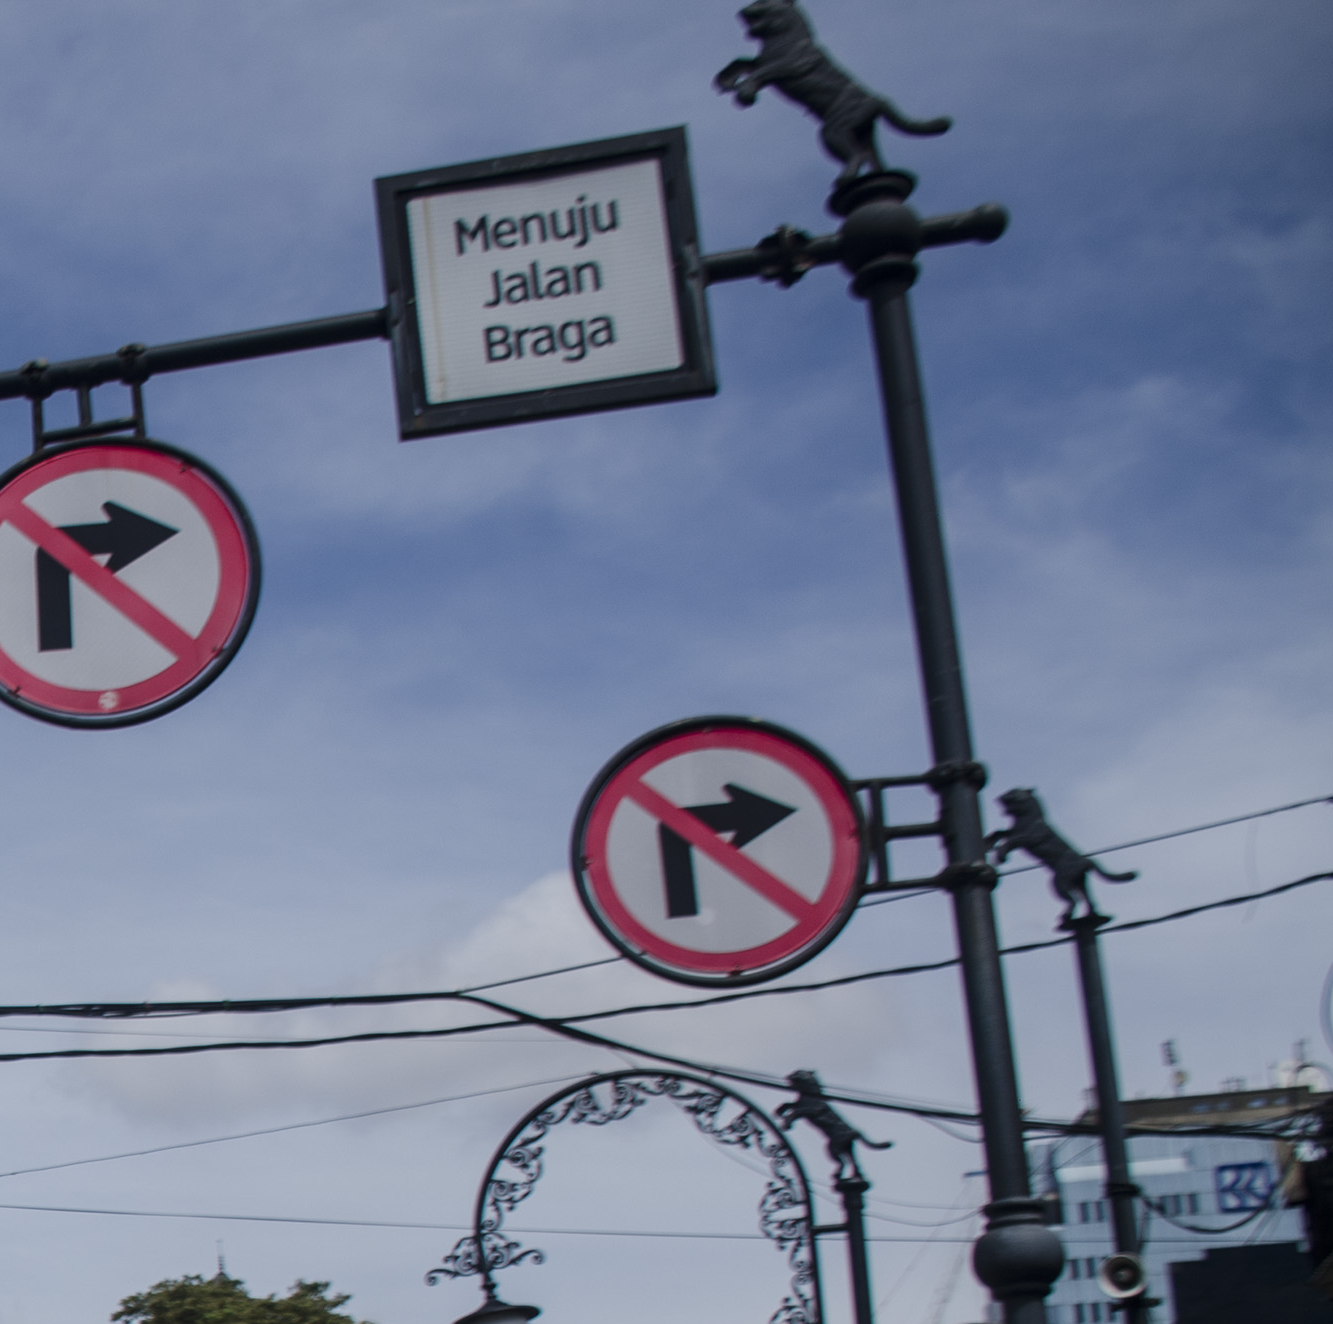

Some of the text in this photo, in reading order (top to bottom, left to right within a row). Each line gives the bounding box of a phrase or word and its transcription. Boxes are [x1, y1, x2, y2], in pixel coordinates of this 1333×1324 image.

[454, 194, 620, 256] Menuju
[483, 260, 603, 308] Jalan
[483, 315, 617, 363] Braga
